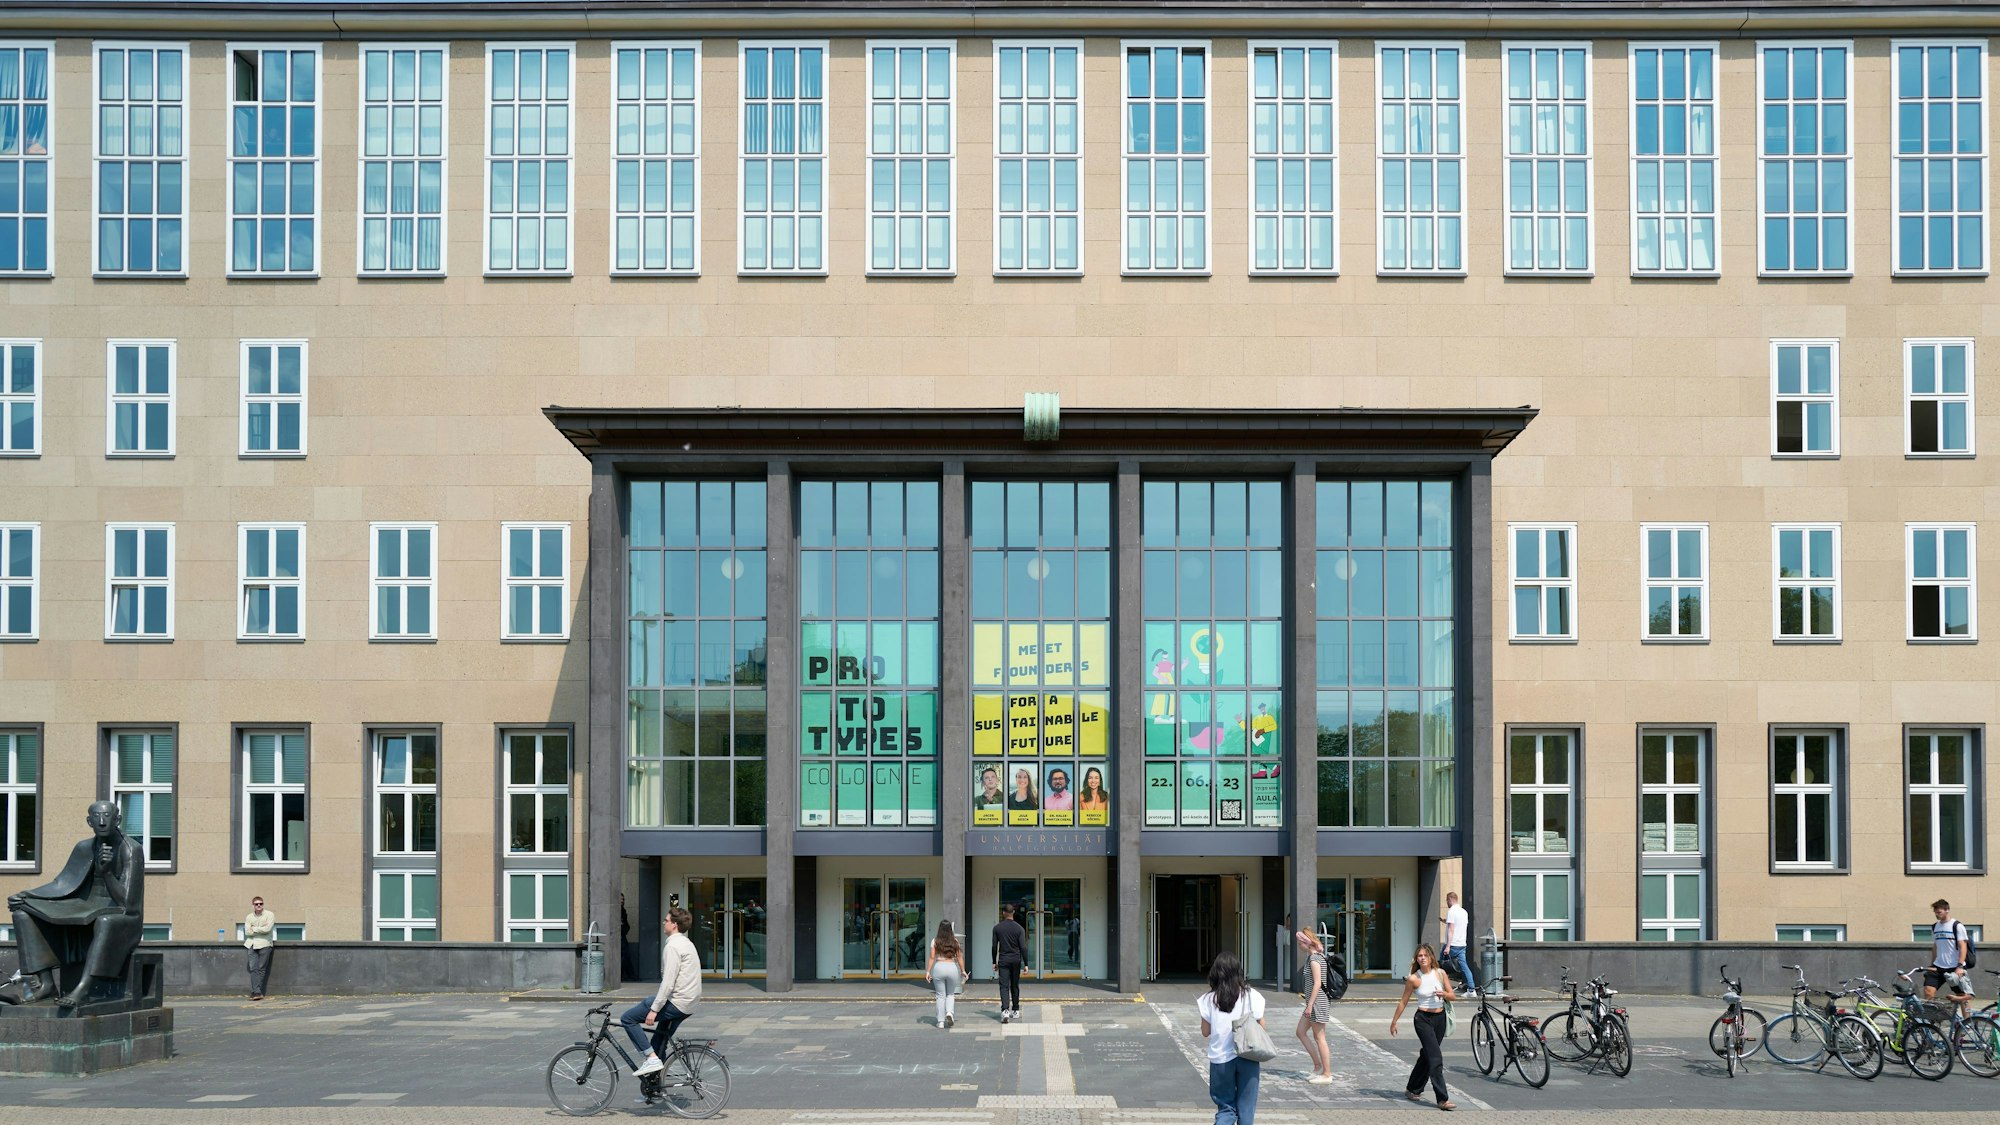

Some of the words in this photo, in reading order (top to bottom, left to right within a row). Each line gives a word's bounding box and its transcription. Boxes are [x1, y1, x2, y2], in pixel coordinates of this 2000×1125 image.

[1018, 643, 1062, 656] MEET
[809, 656, 886, 681] PRO
[839, 697, 886, 721] TO
[1010, 696, 1037, 708] FOR
[1049, 695, 1058, 705] A
[808, 726, 923, 751] TYPES
[1010, 735, 1072, 749] FUTURE
[808, 767, 922, 785] COLOGNE
[1151, 777, 1173, 787] 22.
[1186, 775, 1209, 788] 06.
[1223, 777, 1240, 790] 23
[981, 833, 1102, 844] UNIVERSITÄT
